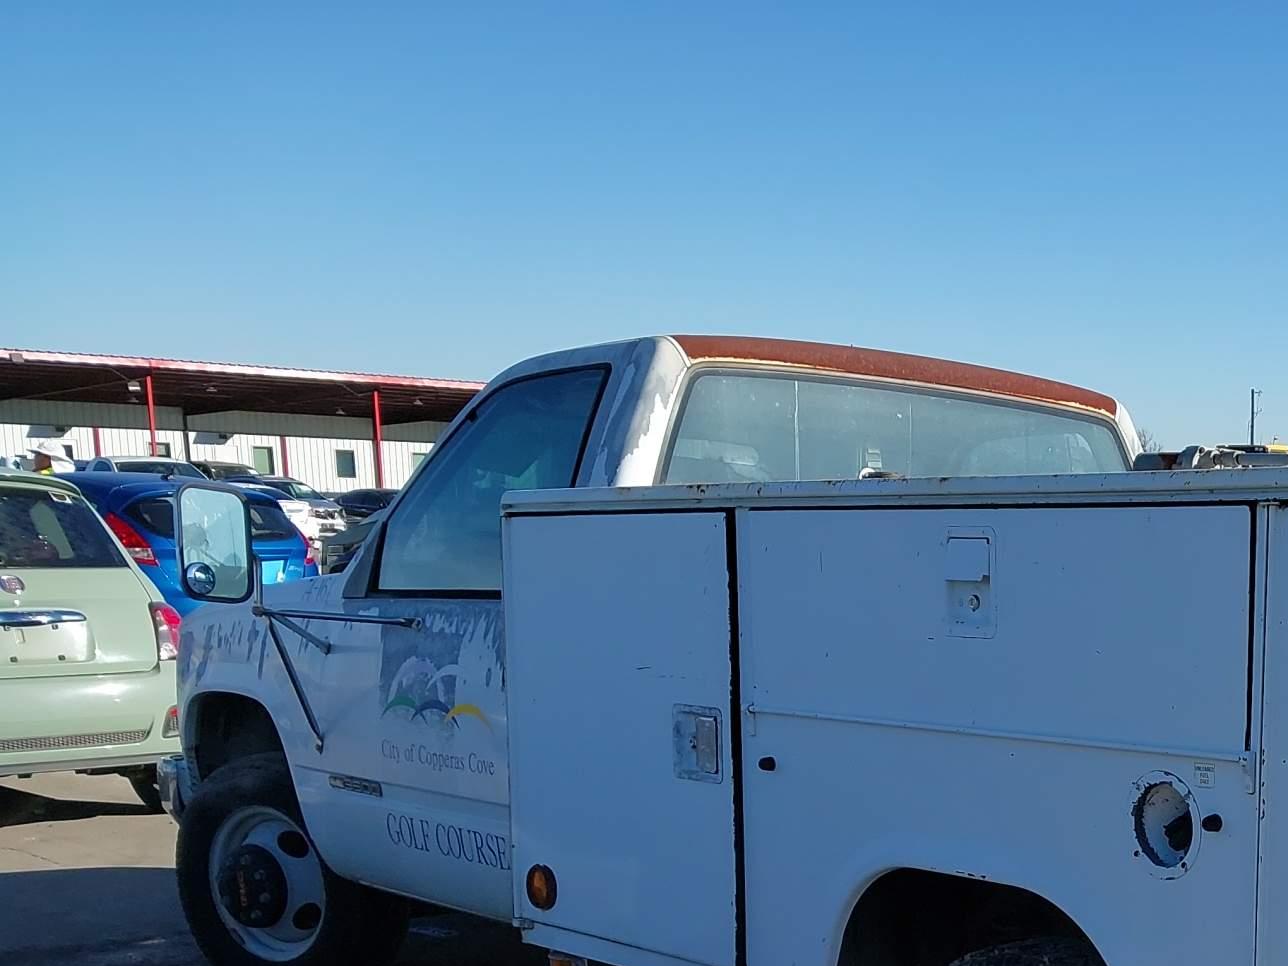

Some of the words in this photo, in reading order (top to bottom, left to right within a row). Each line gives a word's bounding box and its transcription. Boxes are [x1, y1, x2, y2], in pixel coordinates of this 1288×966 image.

[381, 738, 400, 765] City
[404, 743, 416, 763] of
[418, 744, 465, 773] Copperas
[468, 752, 495, 776] Cove
[386, 812, 431, 853] GOLF
[436, 823, 511, 871] COURSE
